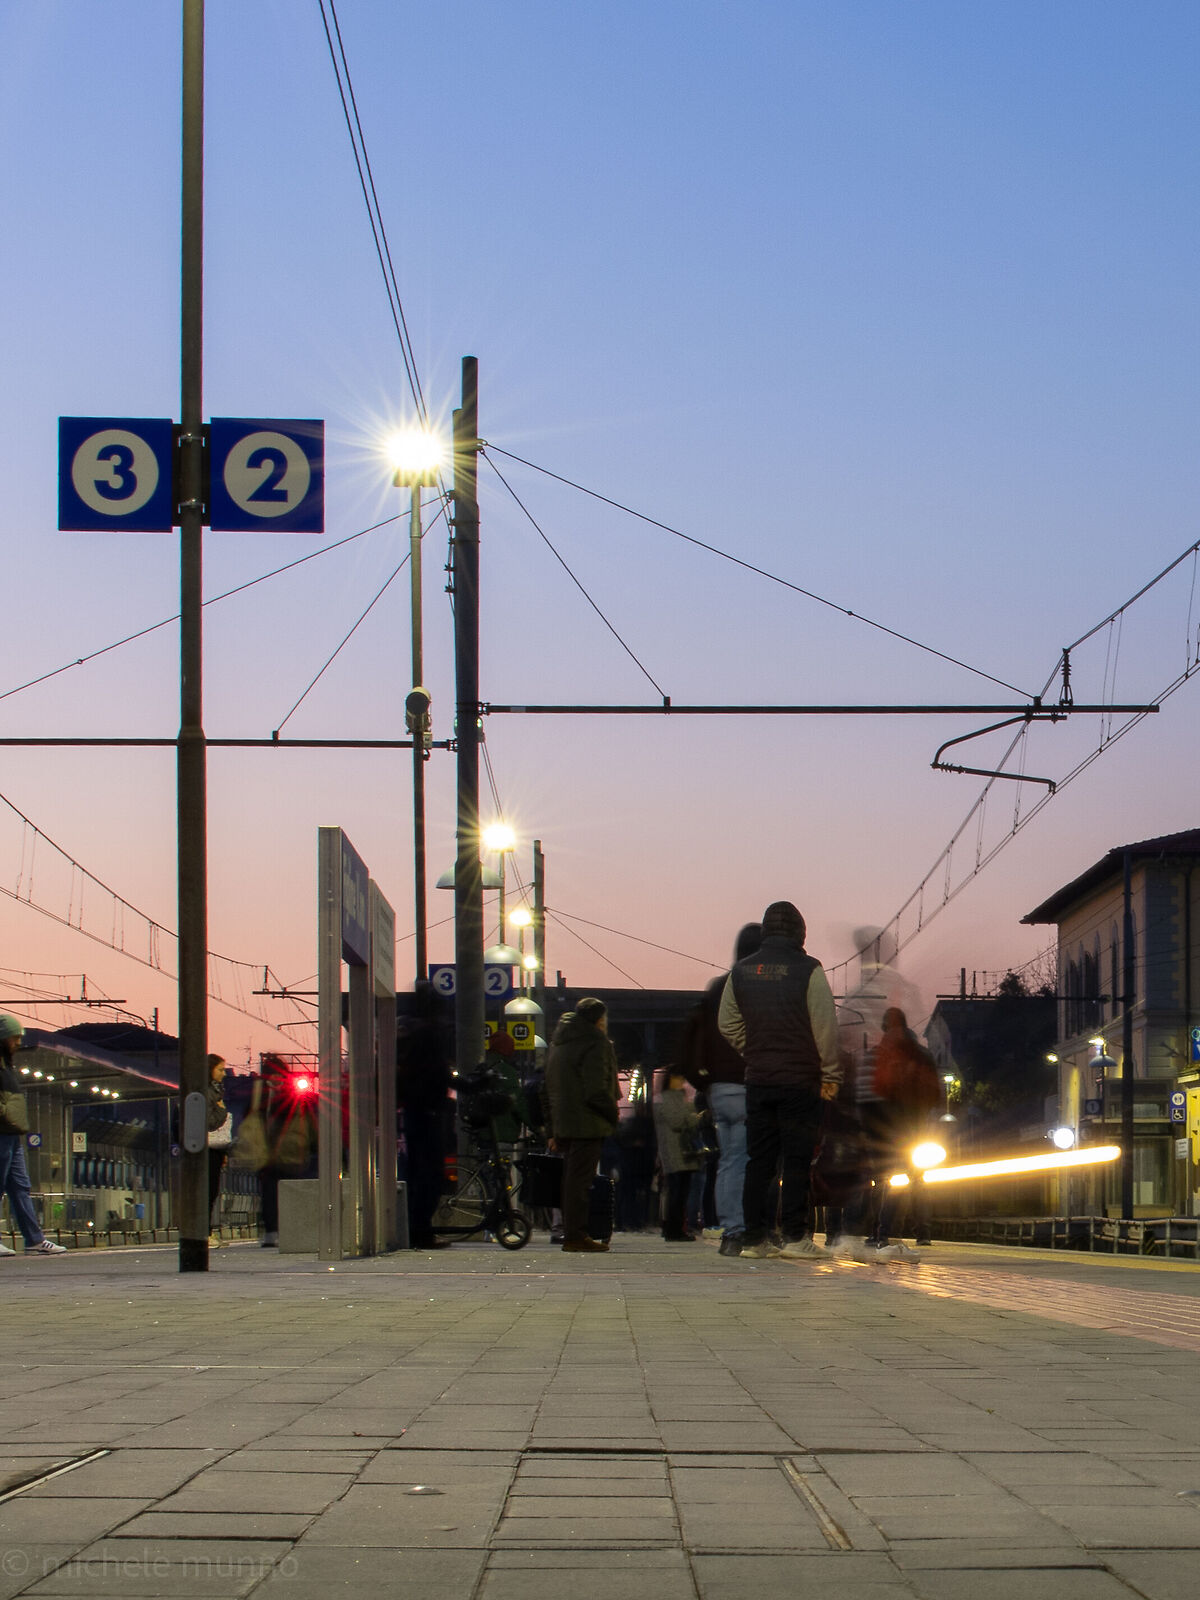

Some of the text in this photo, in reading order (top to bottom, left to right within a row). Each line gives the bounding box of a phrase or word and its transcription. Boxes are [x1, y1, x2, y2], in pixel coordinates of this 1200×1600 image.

[94, 444, 138, 501] 3
[246, 446, 289, 502] 2
[439, 972, 454, 991] 3
[488, 972, 502, 991] 2
